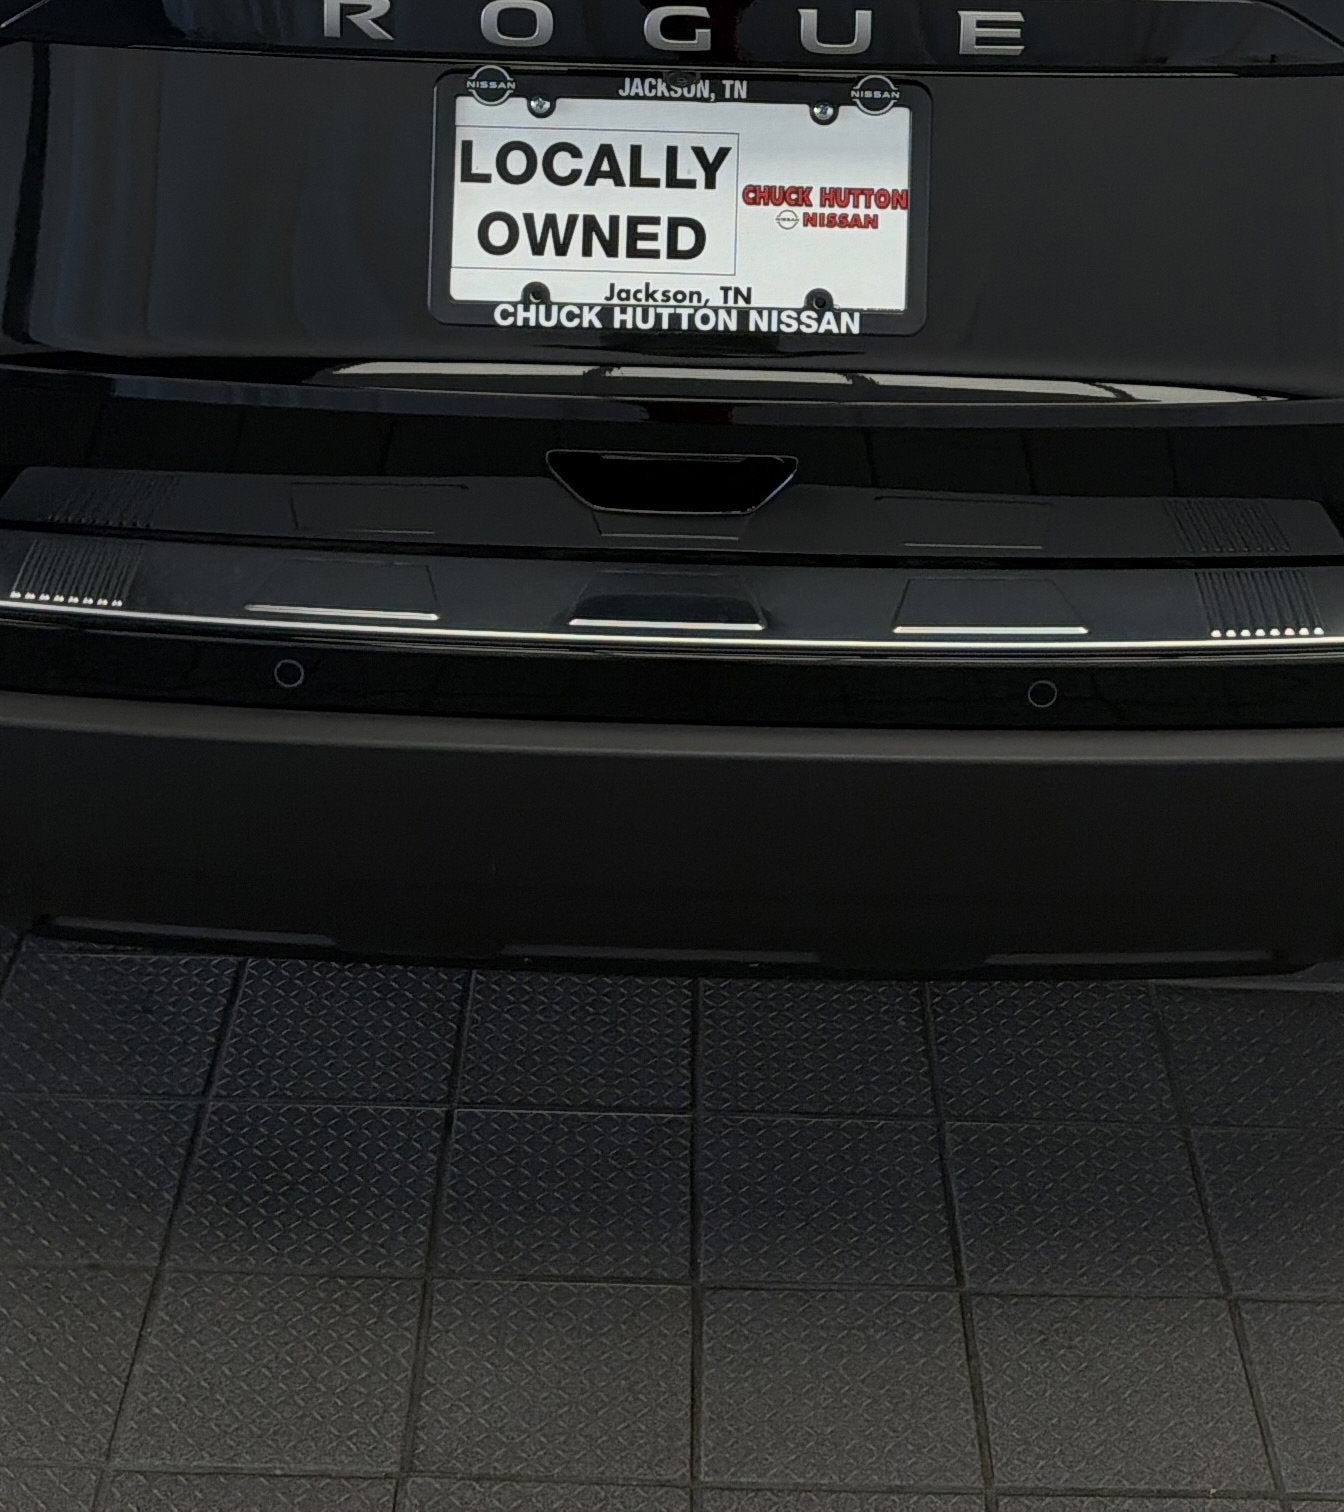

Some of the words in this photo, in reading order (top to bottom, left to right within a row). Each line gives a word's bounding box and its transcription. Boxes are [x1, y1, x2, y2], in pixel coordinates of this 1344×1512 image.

[721, 79, 748, 99] TN
[459, 139, 732, 190] LOCALLY
[742, 184, 813, 207] CHUCK
[819, 187, 908, 210] HUTTON
[802, 212, 879, 229] NISSAN
[477, 211, 706, 261] OWNED
[604, 283, 710, 306] Jackson,
[719, 286, 753, 305] TN
[493, 303, 603, 329] CHUCK
[613, 308, 738, 332] HUTTON
[748, 310, 860, 335] NISSAN
